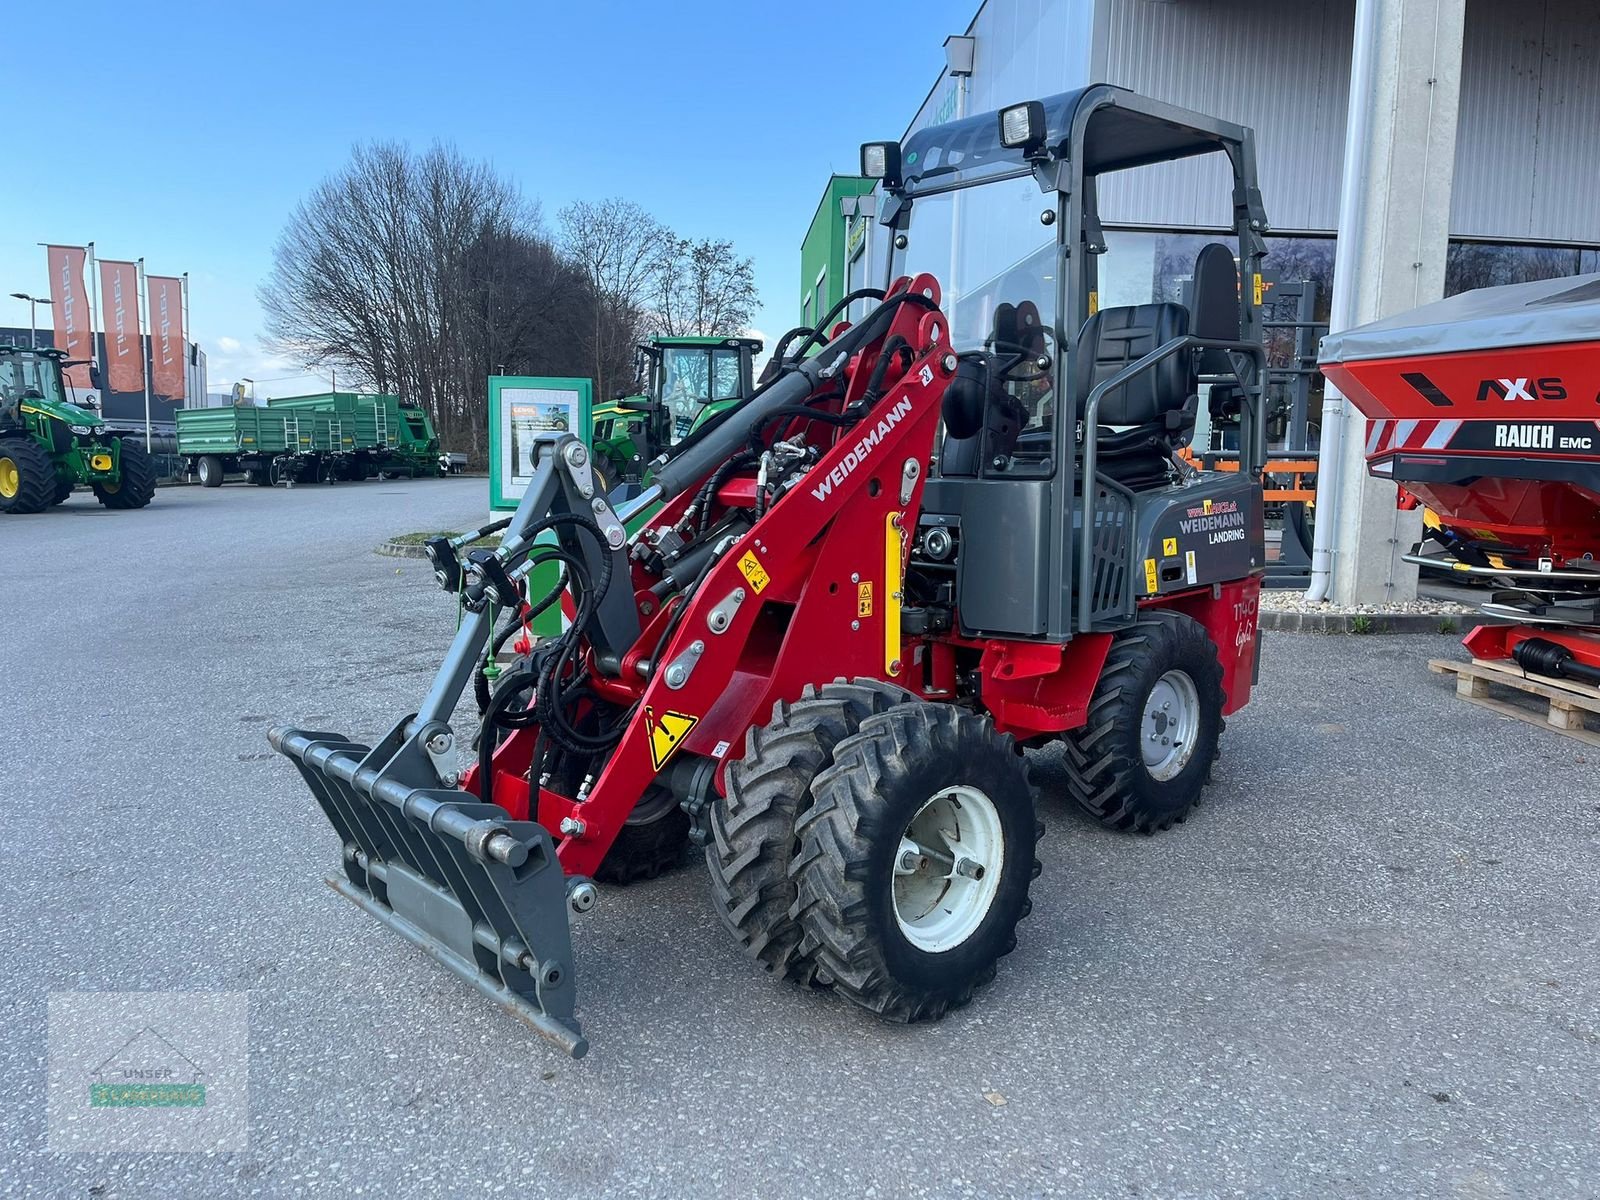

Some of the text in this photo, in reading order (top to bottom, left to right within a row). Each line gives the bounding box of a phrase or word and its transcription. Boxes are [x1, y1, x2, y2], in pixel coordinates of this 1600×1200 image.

[1476, 378, 1567, 401] AXIS
[811, 395, 912, 502] WEIDEMANN
[1495, 425, 1592, 449] RAUCH EMC
[1179, 512, 1244, 534] WEIDEMANN
[1208, 528, 1245, 545] LANDRING
[1233, 598, 1255, 621] 1140
